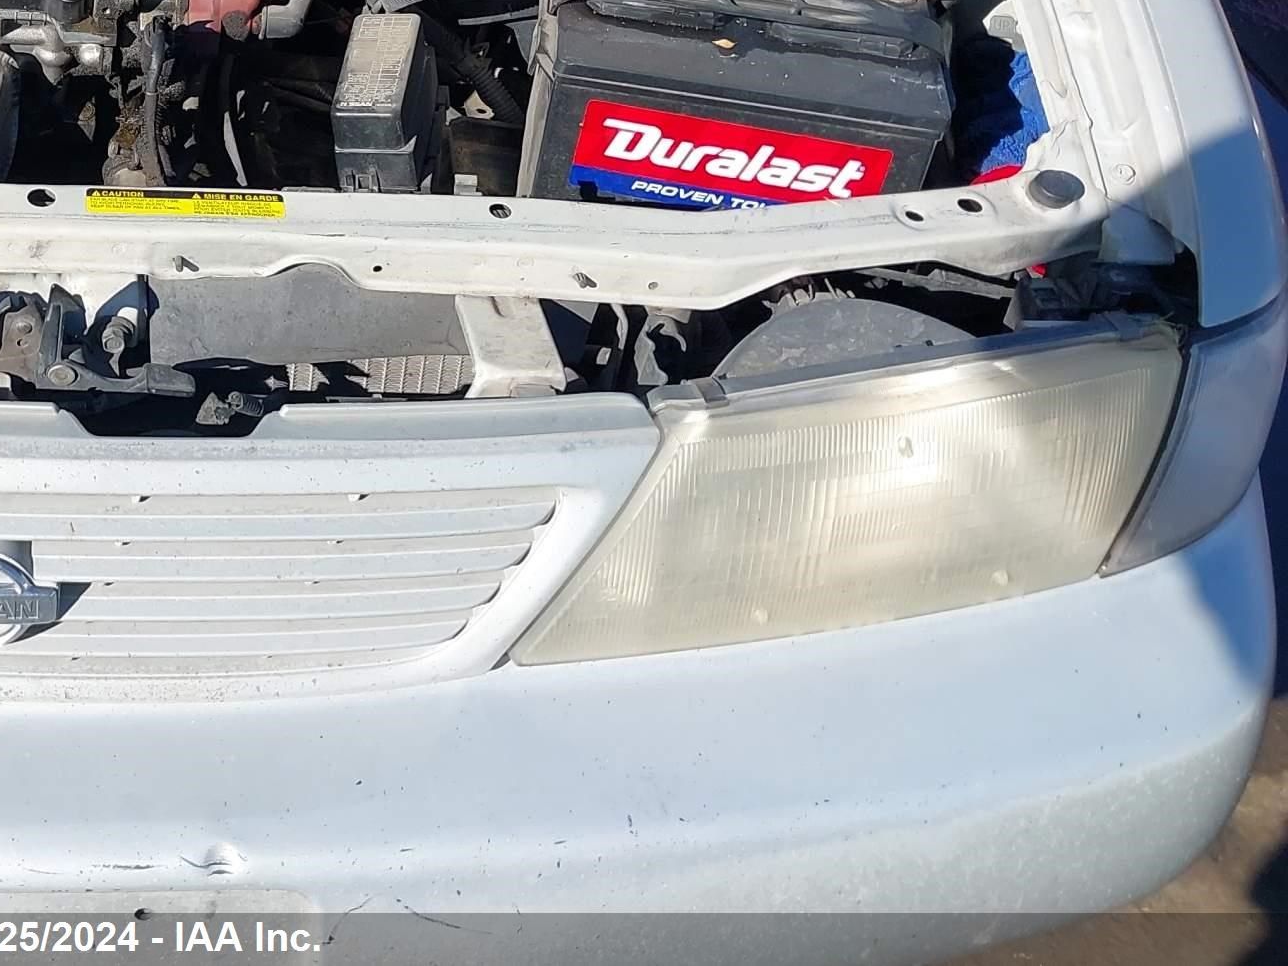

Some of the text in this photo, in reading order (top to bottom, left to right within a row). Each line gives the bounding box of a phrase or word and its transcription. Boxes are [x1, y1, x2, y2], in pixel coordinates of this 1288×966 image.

[602, 118, 865, 199] Duralast
[101, 190, 145, 198] CAUTION
[203, 193, 227, 201] MISE
[244, 194, 279, 202] GARDE
[630, 180, 724, 205] PROVEN
